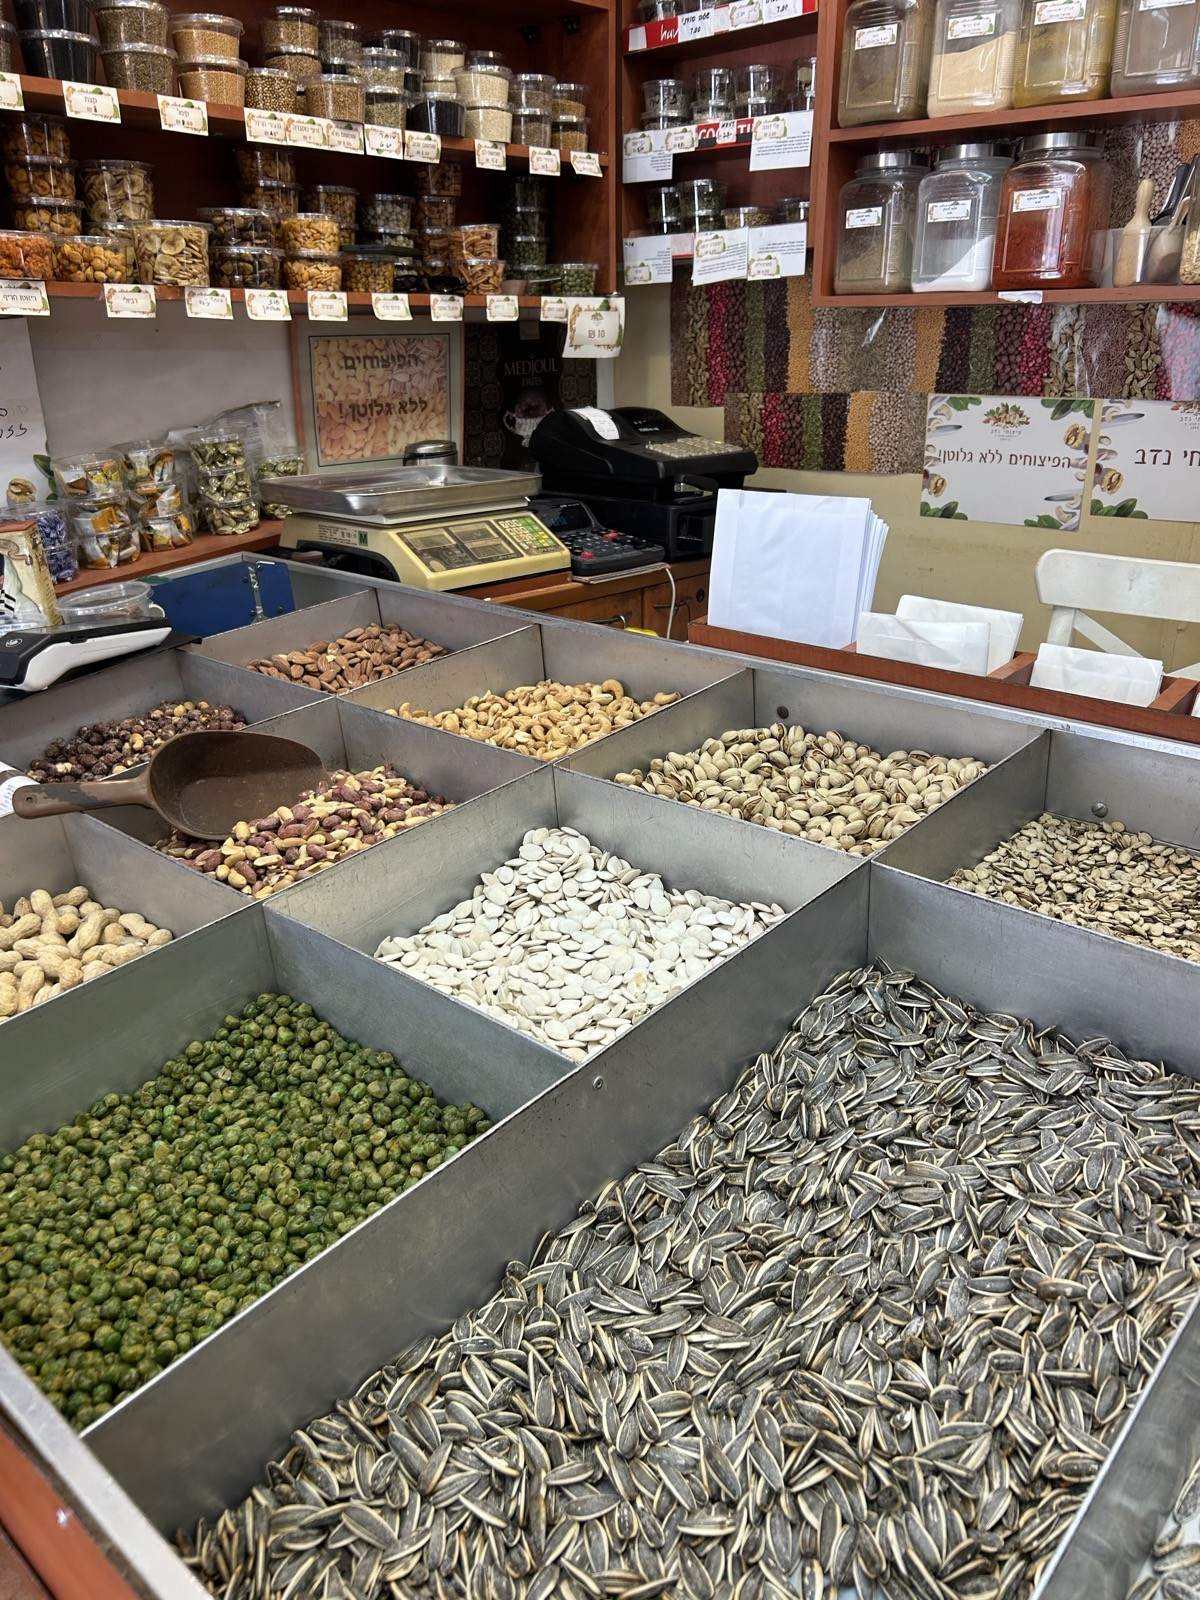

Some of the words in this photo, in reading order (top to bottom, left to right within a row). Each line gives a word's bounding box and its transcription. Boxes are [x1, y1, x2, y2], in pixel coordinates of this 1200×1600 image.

[598, 329, 606, 338] 10
[343, 353, 421, 370] הפיצוחים
[398, 397, 428, 415] ללא
[938, 447, 973, 465] גלוטן!
[979, 448, 1003, 464] ללא
[1008, 452, 1071, 469] הפיצוחים
[1135, 448, 1172, 466] נדב
